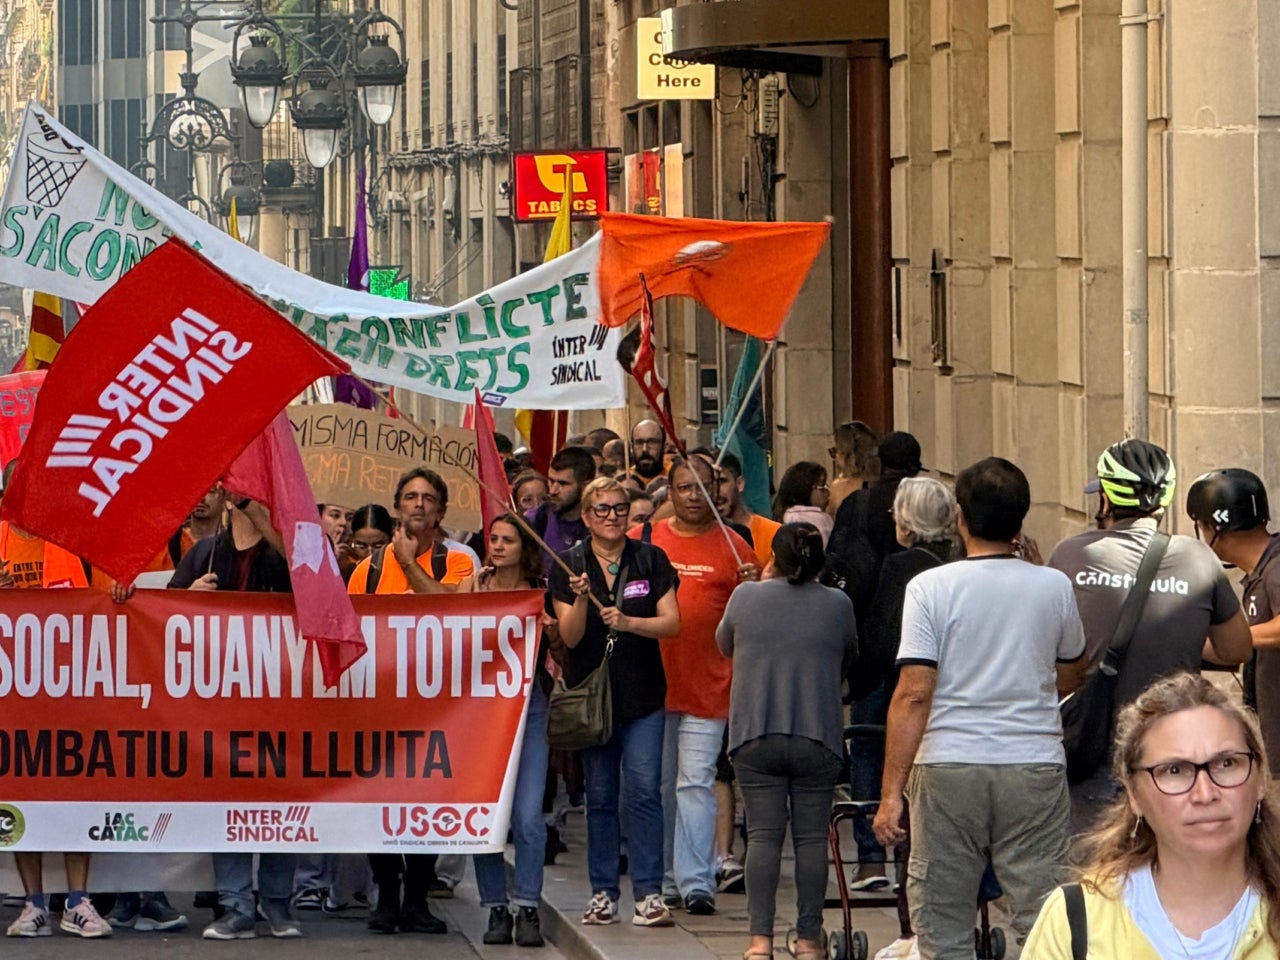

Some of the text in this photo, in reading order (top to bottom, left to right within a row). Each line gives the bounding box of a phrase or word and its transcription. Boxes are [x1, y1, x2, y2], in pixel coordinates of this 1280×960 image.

[657, 74, 702, 87] Here
[527, 199, 597, 213] TABCS
[404, 342, 531, 394] DRETS
[289, 414, 368, 449] MISMA
[388, 614, 537, 699] TOTES!
[204, 730, 214, 778] I
[229, 729, 287, 778] EN
[302, 730, 453, 779] LLUITA
[226, 809, 283, 825] INTER
[382, 806, 490, 838] USOC
[88, 825, 150, 842] CATAC
[226, 826, 320, 843] SINDICAL
